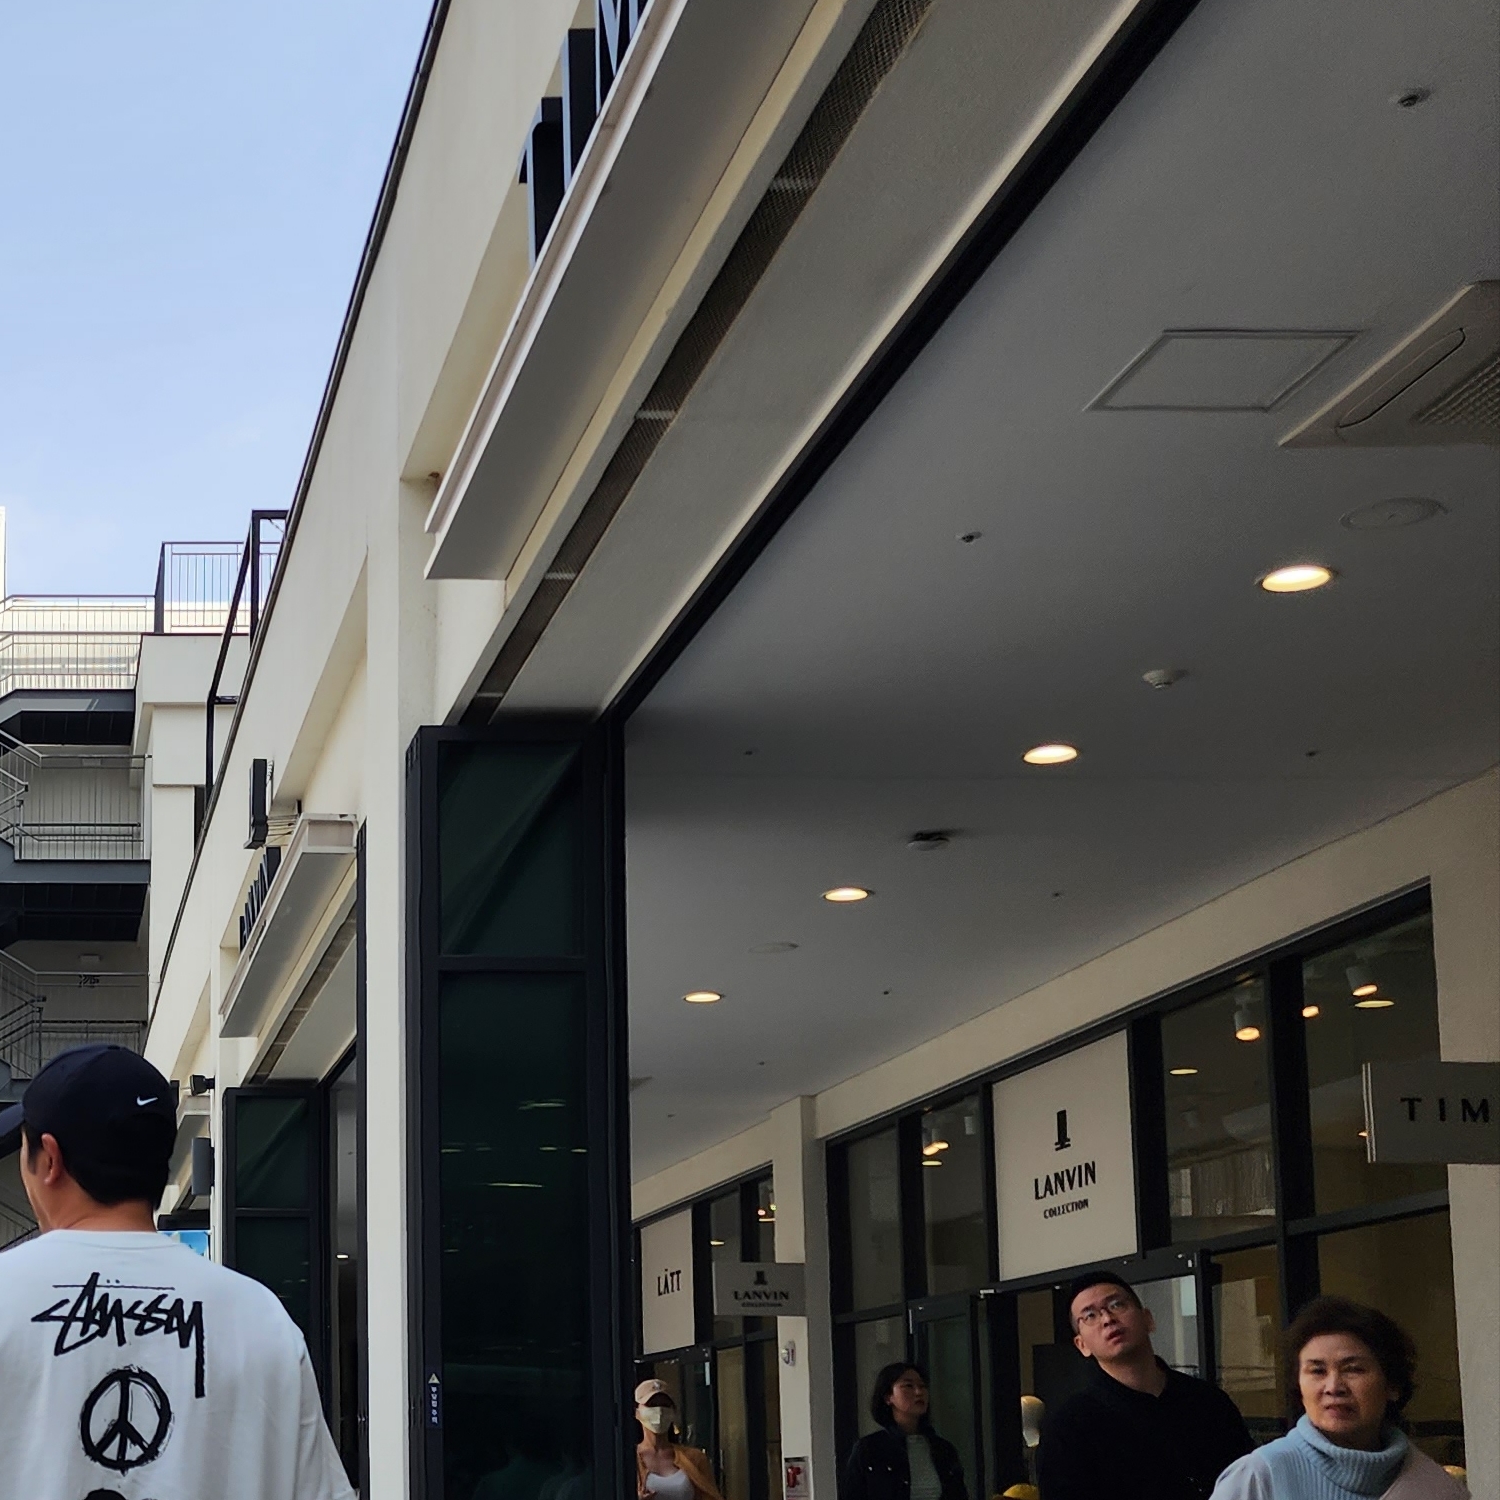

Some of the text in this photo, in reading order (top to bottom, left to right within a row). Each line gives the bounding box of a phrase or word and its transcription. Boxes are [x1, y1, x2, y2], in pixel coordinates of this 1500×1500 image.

[1400, 1097, 1490, 1123] TIM
[1034, 1160, 1096, 1201] LANVIN
[1043, 1198, 1089, 1219] COLLECTION
[733, 1290, 790, 1301] LANVIN
